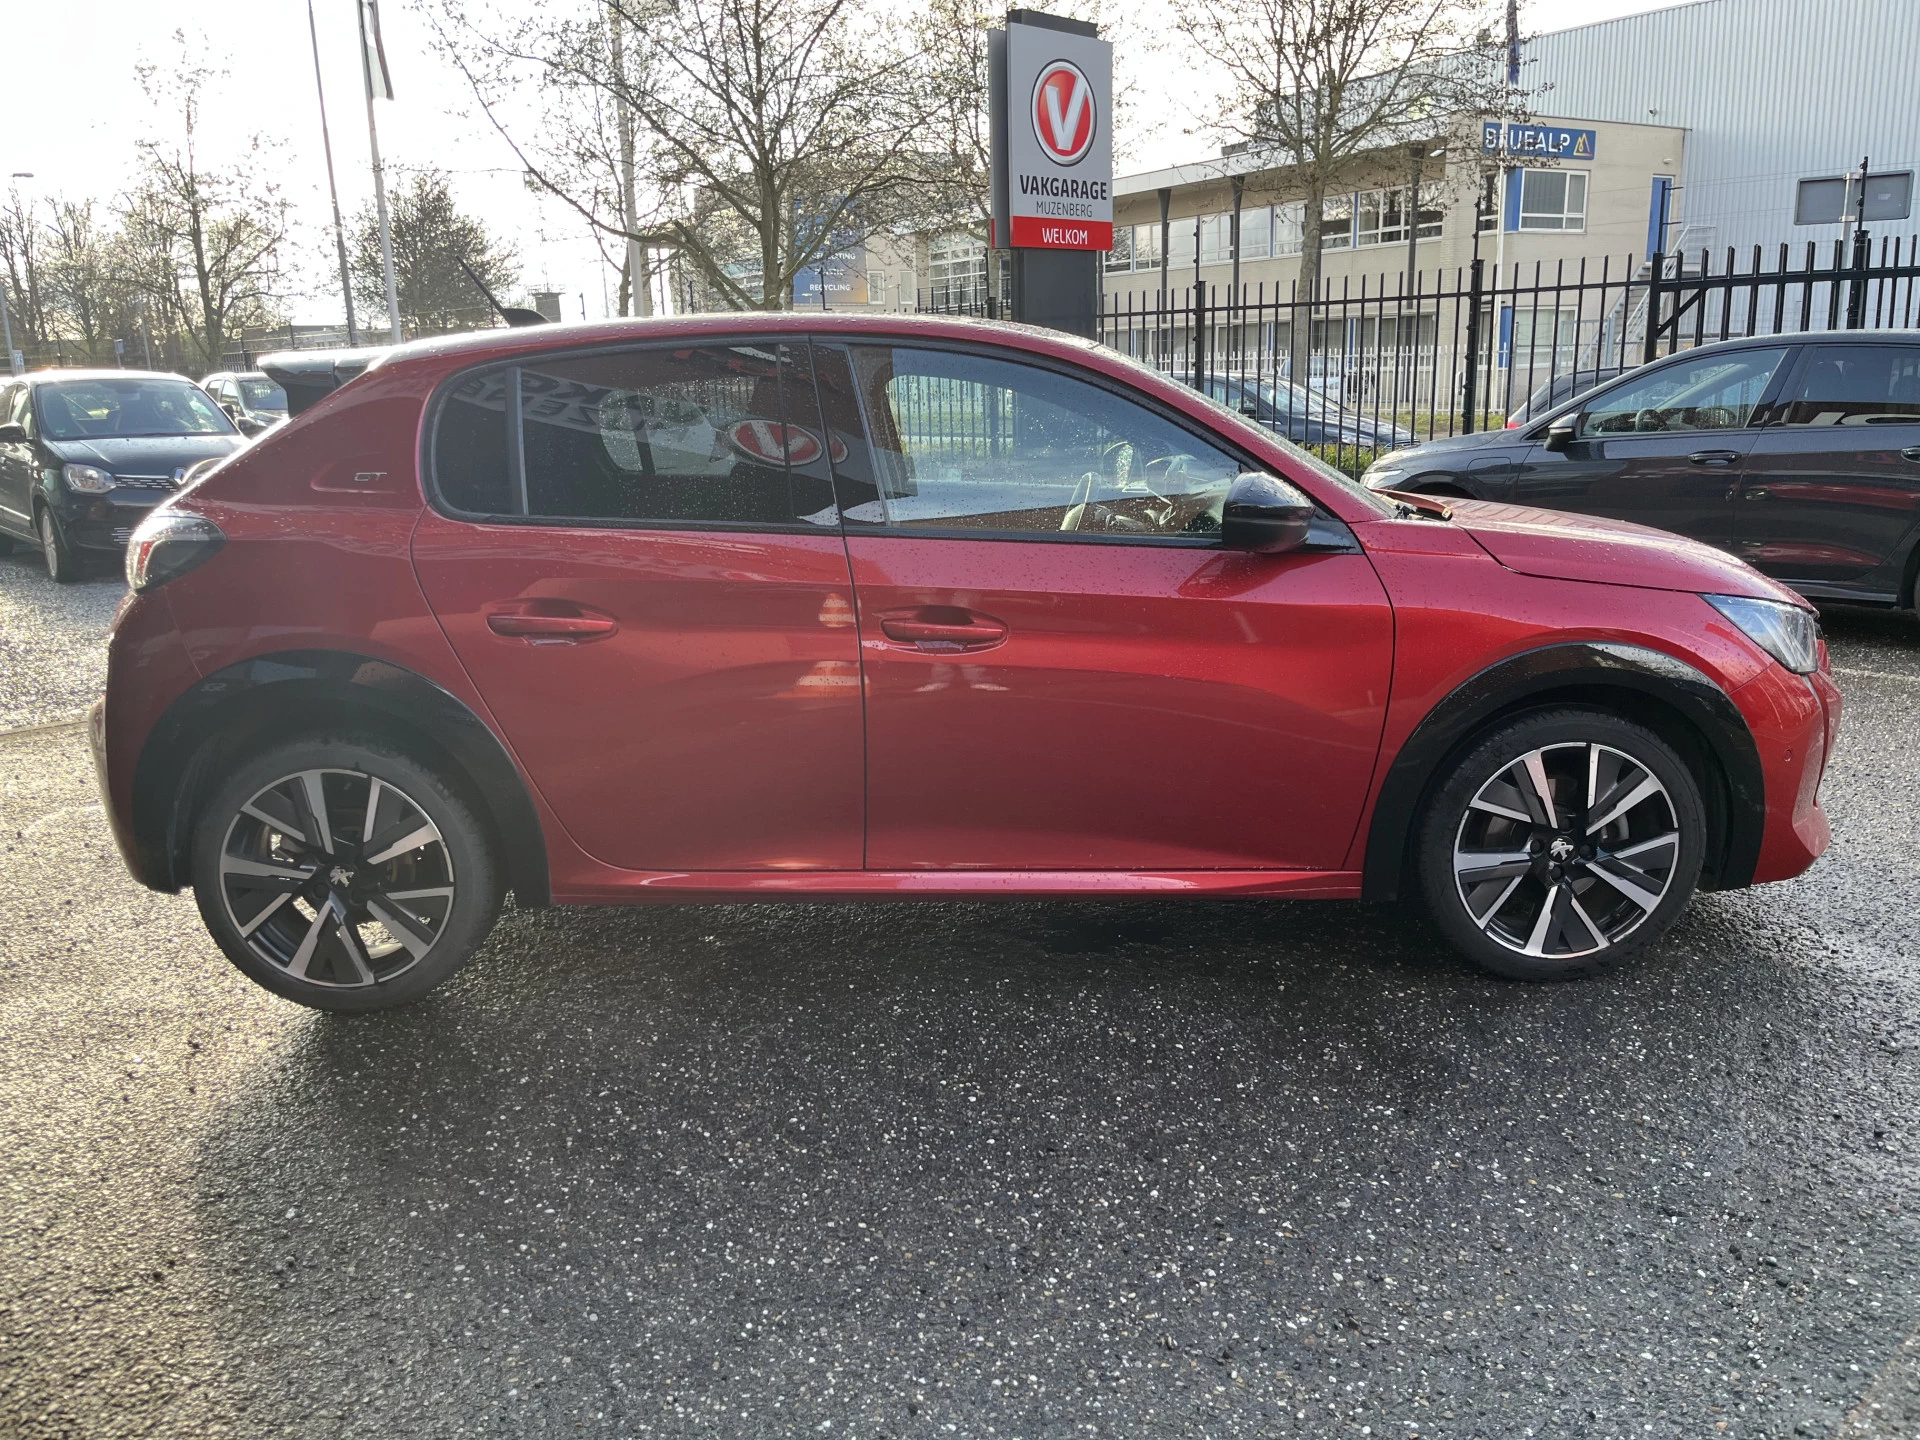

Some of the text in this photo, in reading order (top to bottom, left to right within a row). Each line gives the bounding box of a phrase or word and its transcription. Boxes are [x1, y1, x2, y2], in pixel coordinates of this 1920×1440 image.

[1045, 72, 1088, 151] V
[1019, 174, 1107, 201] VAKGARAGE
[1036, 200, 1093, 218] MUZENBERG
[1041, 227, 1088, 246] WELKOM
[354, 472, 388, 482] GT
